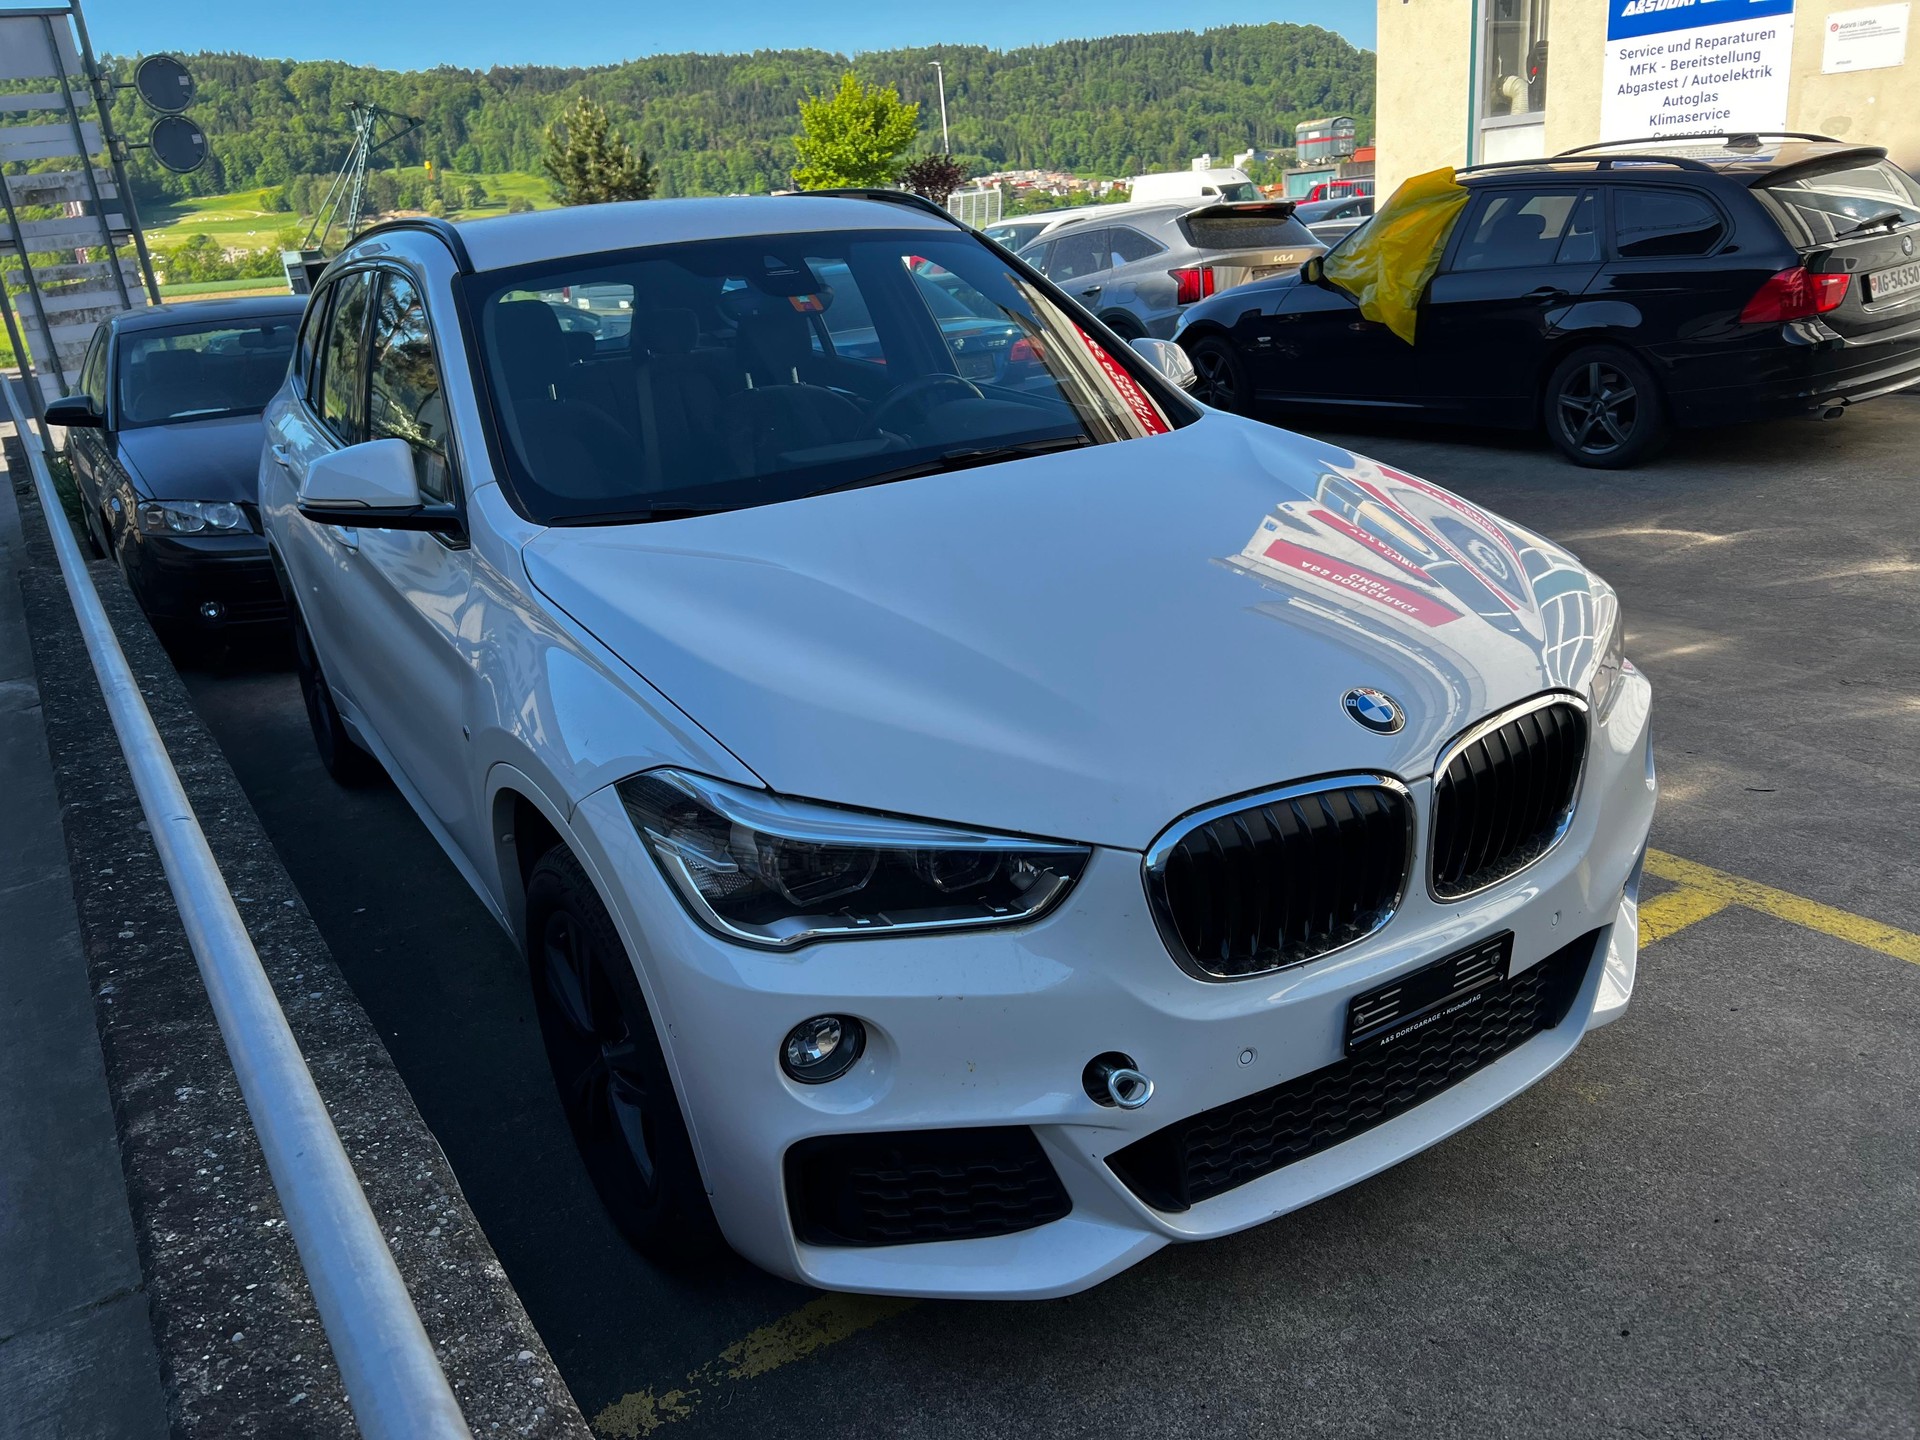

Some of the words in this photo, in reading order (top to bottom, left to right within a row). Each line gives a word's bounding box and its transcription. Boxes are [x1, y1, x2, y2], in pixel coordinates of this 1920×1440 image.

[1619, 44, 1664, 60] Service
[1667, 39, 1691, 53] und
[1694, 29, 1776, 50] Reparaturen
[1630, 62, 1657, 76] MFK
[1670, 50, 1761, 71] Bereitstellung
[1617, 77, 1679, 96] Abgastest
[1691, 65, 1773, 86] Autoelektrik
[1662, 91, 1719, 107] Autoglas
[1649, 107, 1731, 126] Klimaservice
[1380, 1034, 1394, 1046] A&S
[1395, 1012, 1441, 1038] DORFGARAGE
[1471, 993, 1482, 1003] AG
